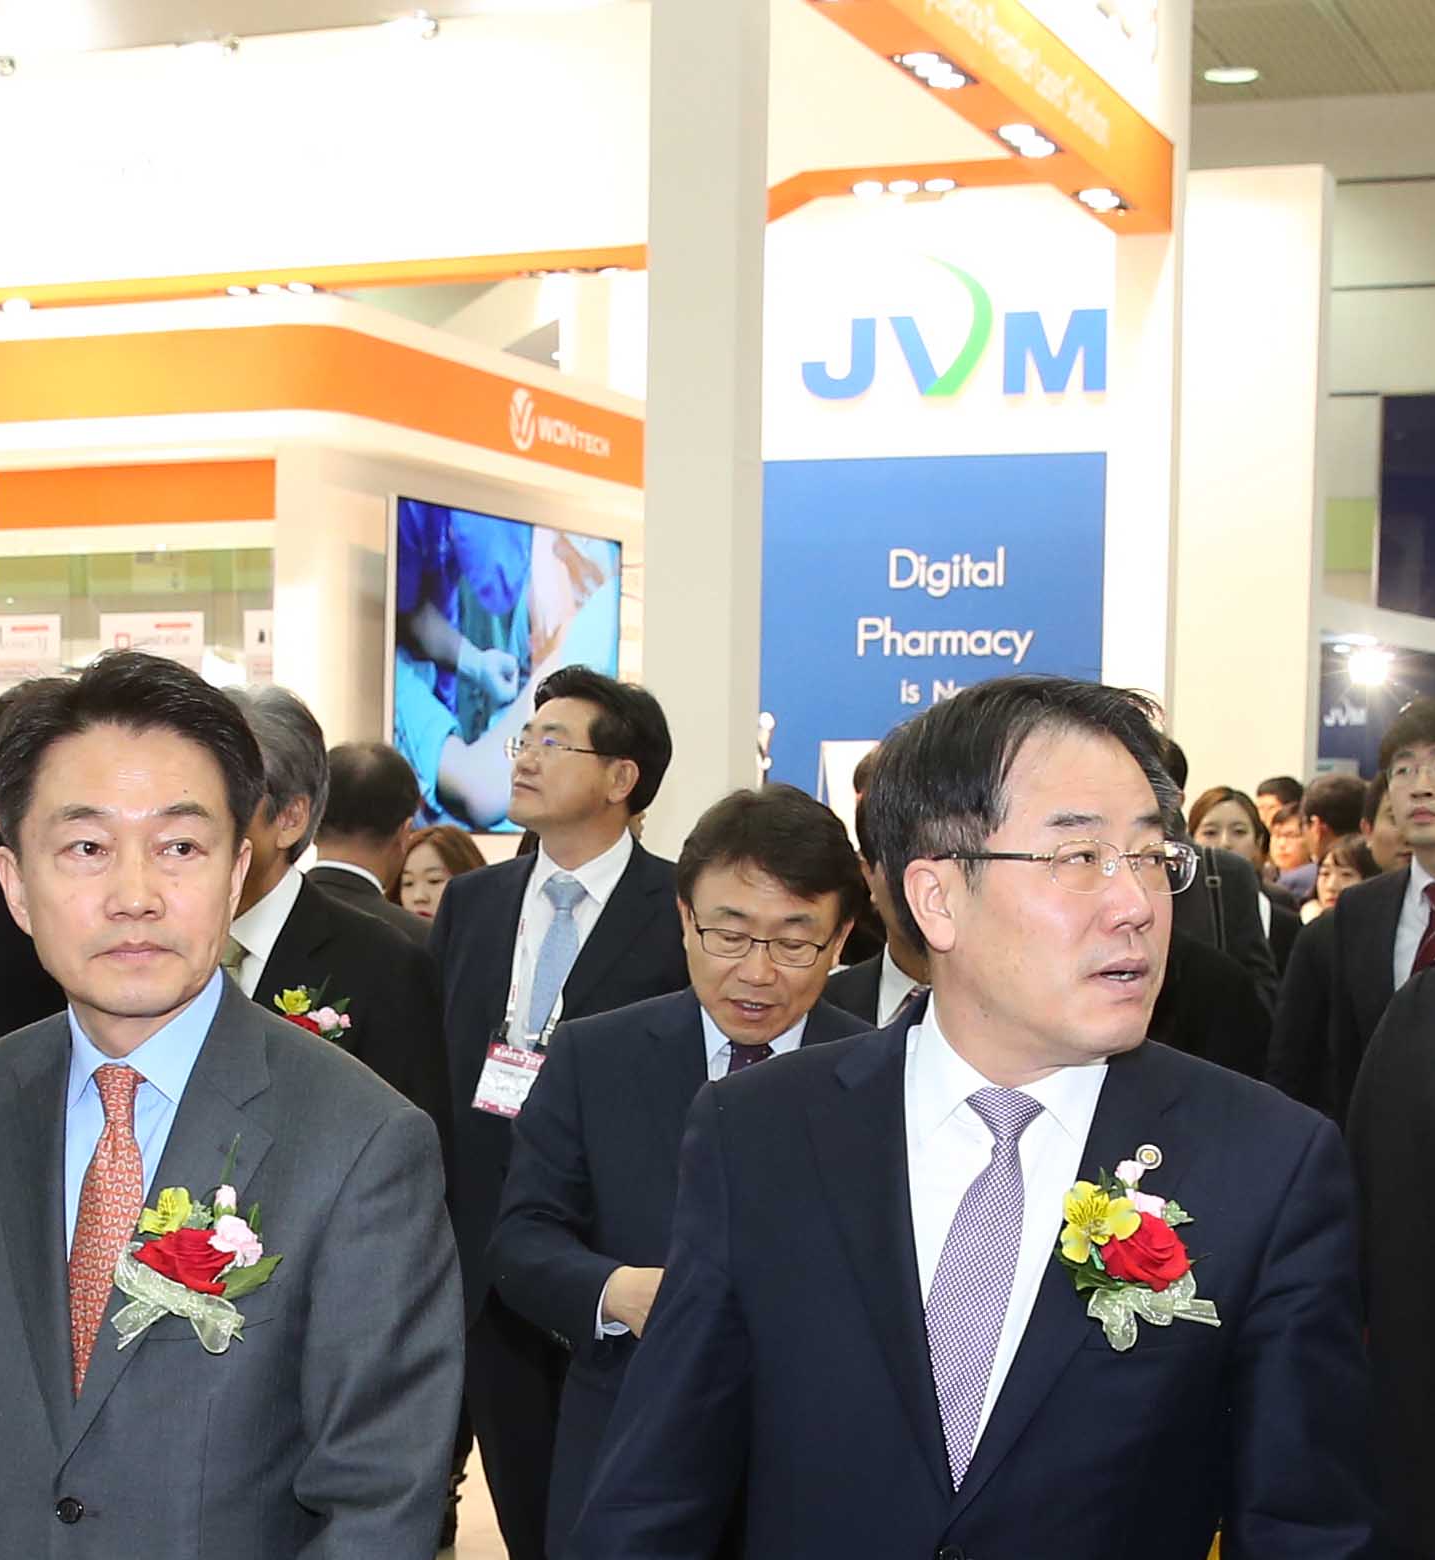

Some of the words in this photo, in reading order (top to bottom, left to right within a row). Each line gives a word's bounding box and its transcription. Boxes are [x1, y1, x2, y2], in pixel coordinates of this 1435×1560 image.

[801, 253, 1108, 401] JVM
[888, 545, 1006, 599] Digital
[856, 616, 1035, 665] Pharmacy
[900, 679, 920, 704] is
